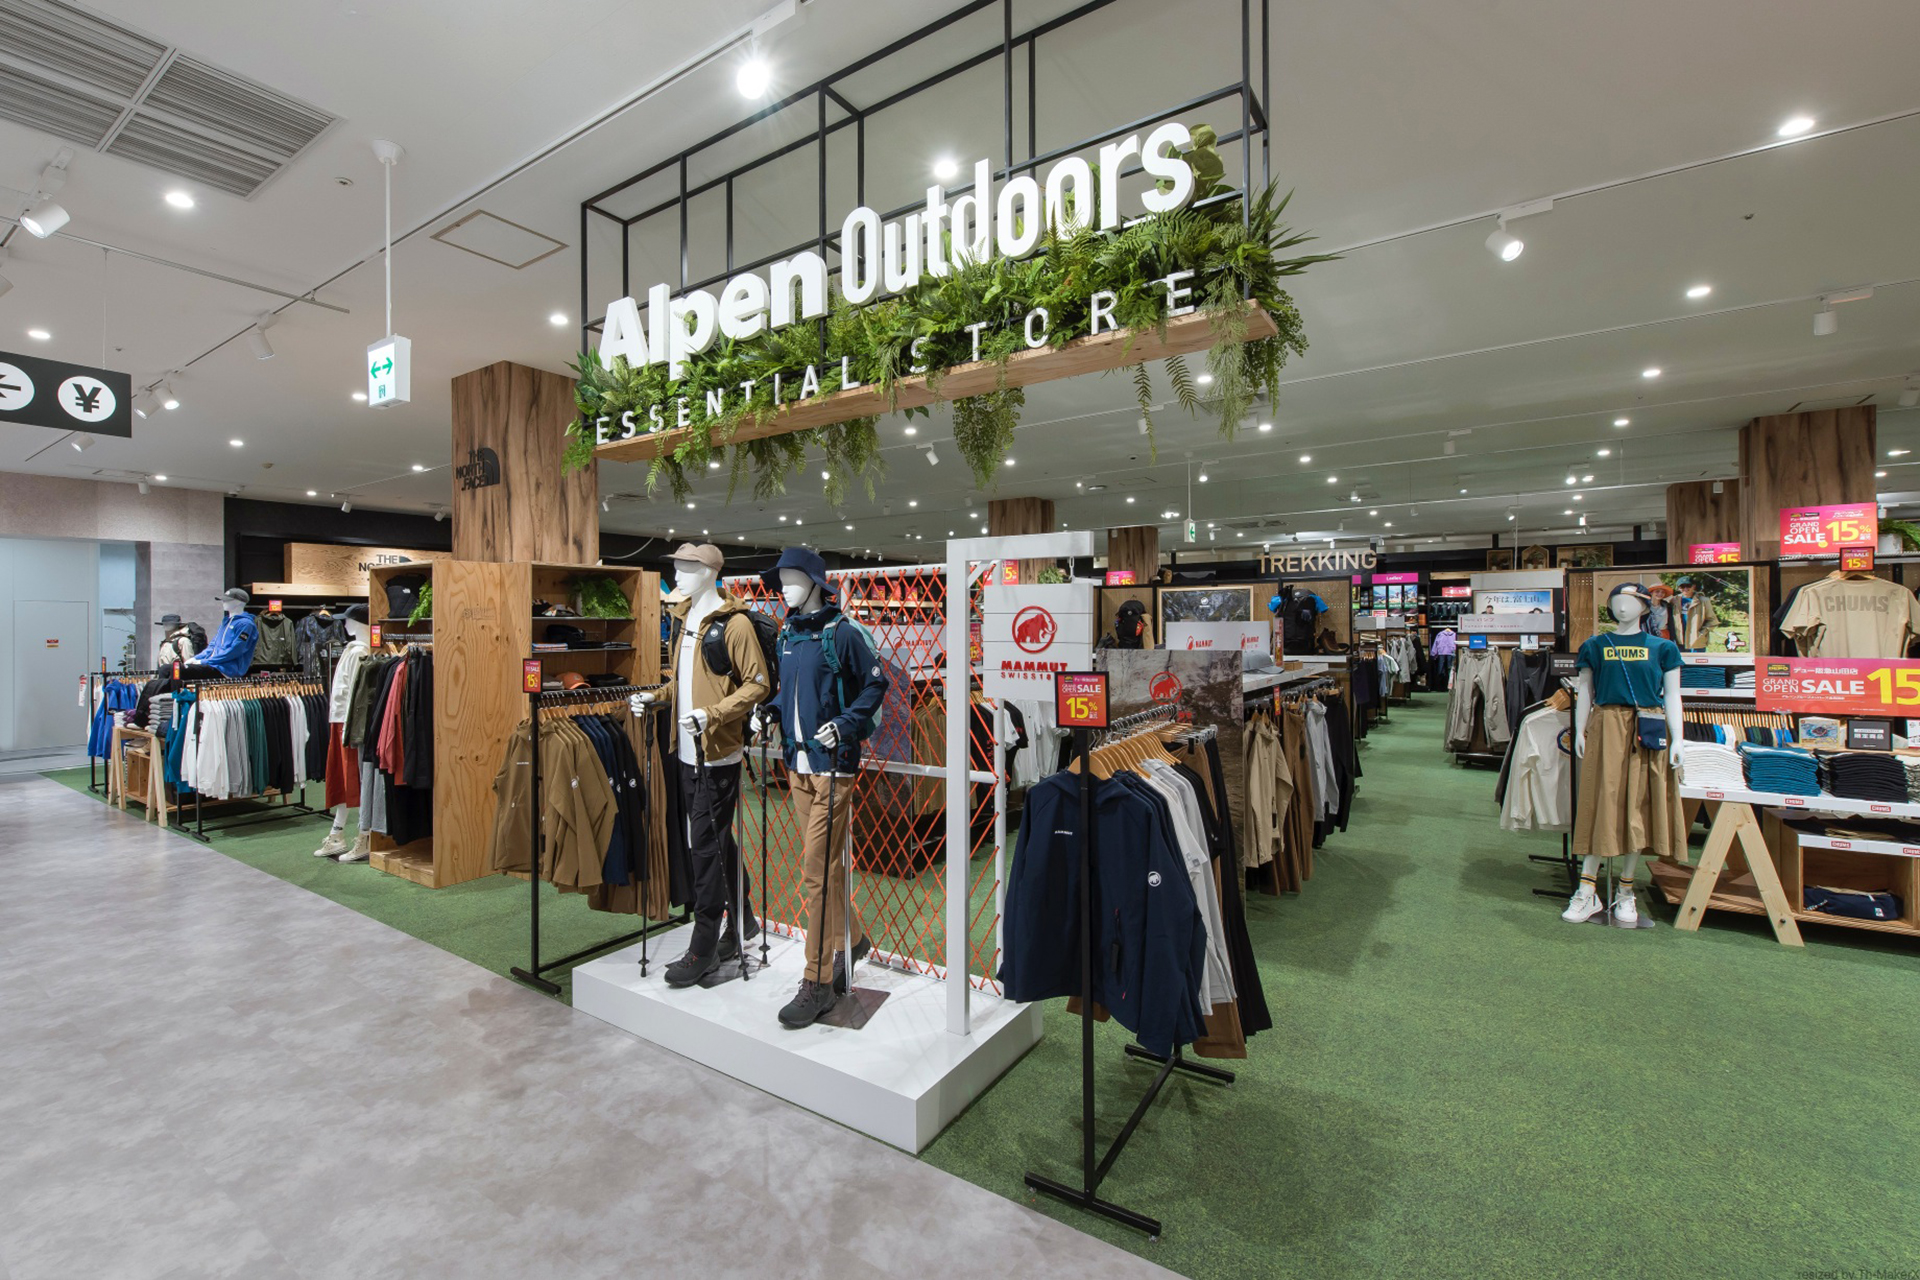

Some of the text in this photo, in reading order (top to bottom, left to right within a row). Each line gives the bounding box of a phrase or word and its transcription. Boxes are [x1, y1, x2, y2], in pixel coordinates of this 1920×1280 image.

[599, 121, 1196, 381] Alpen Outdoors
[595, 270, 1196, 446] ESSENTIAL STORE
[468, 448, 484, 463] THE
[456, 460, 485, 480] NORTH
[1783, 532, 1826, 545] SALE
[376, 554, 398, 564] THE
[1256, 550, 1377, 574] TREKKING
[1823, 594, 1889, 613] CHUMS
[1001, 660, 1068, 673] MAMMUT
[1000, 671, 1036, 680] SWISS
[1762, 678, 1799, 686] GRAND
[1077, 684, 1102, 693] SALE
[1762, 684, 1799, 693] OPEN
[1801, 679, 1866, 695] SALE
